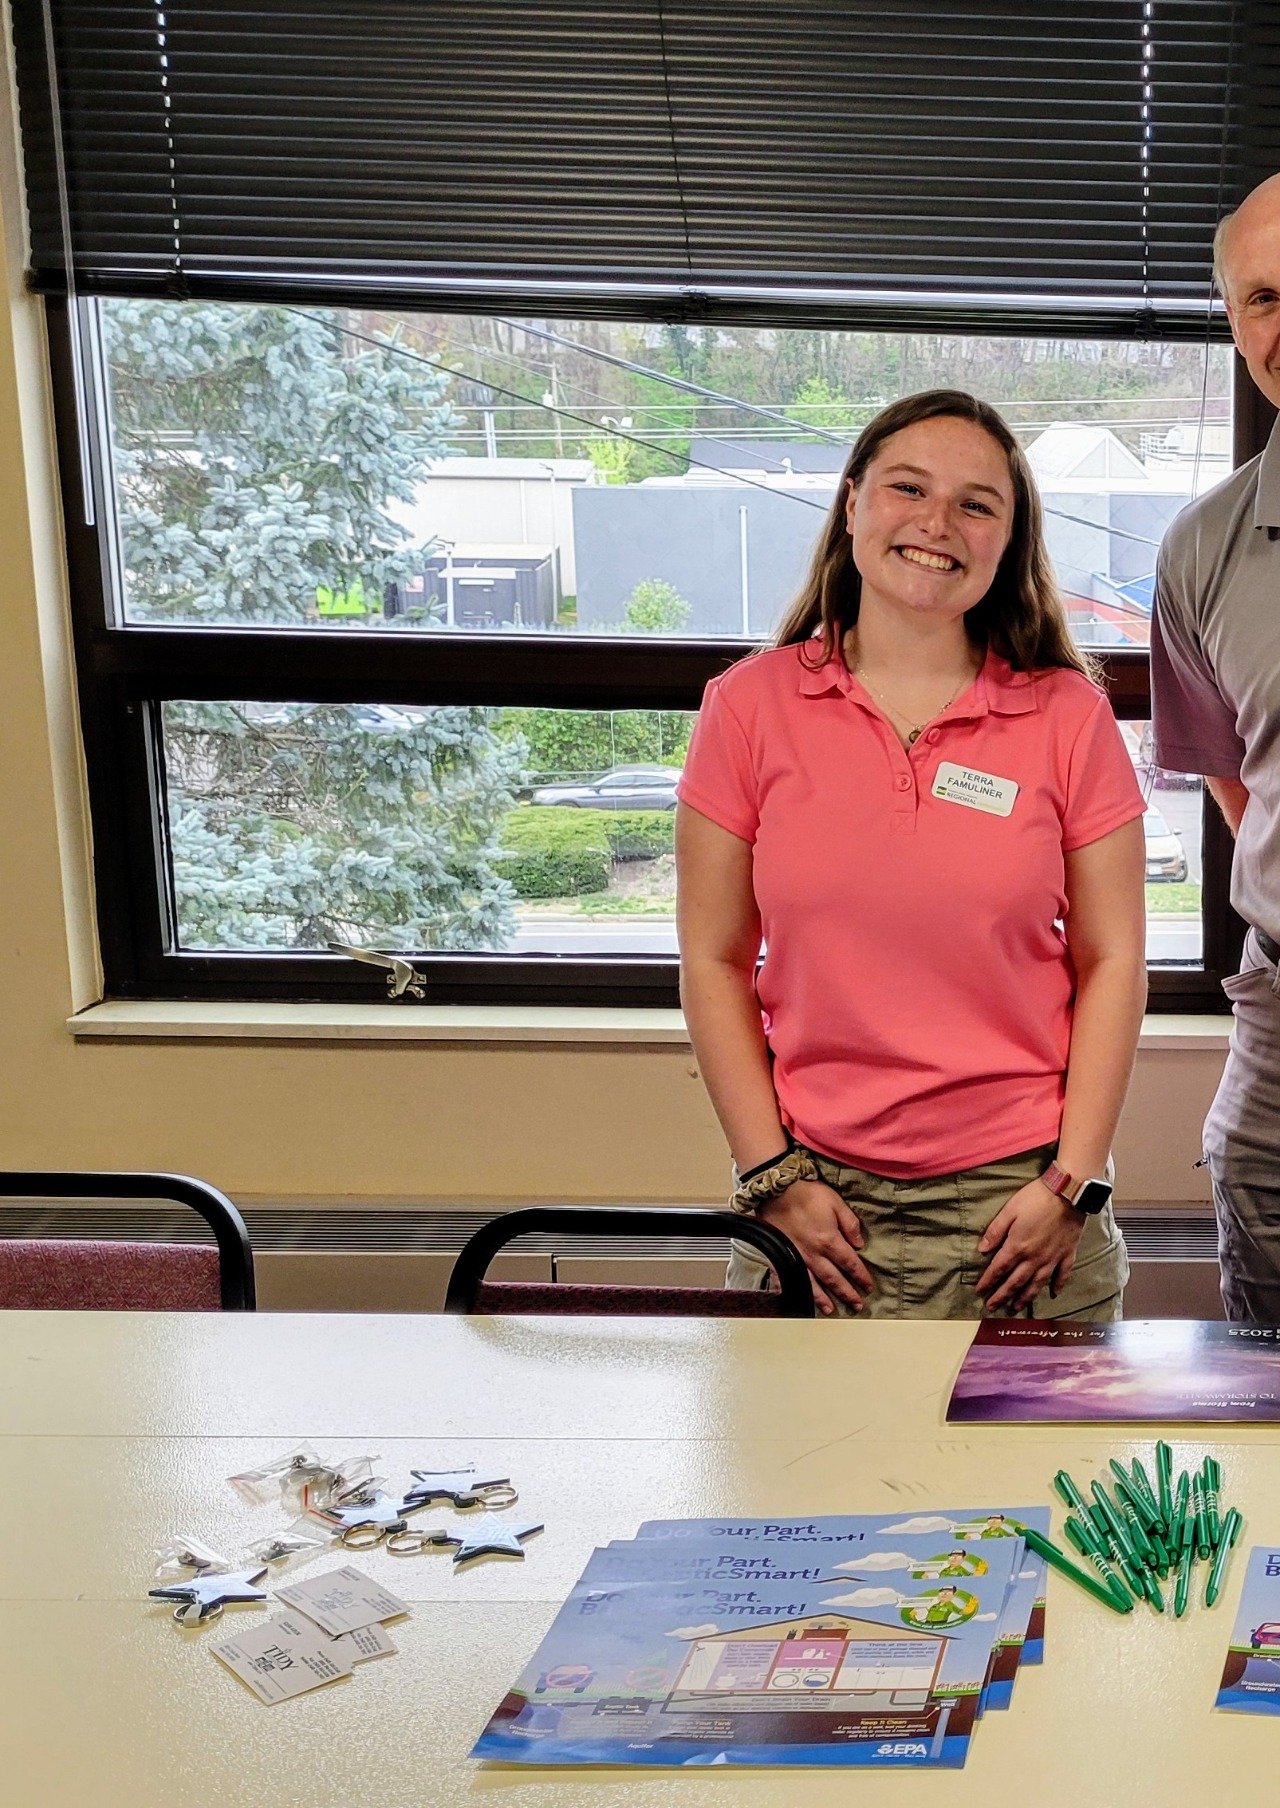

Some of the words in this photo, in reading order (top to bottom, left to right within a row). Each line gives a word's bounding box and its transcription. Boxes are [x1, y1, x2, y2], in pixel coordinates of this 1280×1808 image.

[962, 771, 994, 787] TERRA
[947, 777, 1003, 800] FAMULINER
[1228, 1328, 1274, 1338] 2025
[262, 1644, 299, 1672] TIDY
[893, 1744, 928, 1755] EPA
